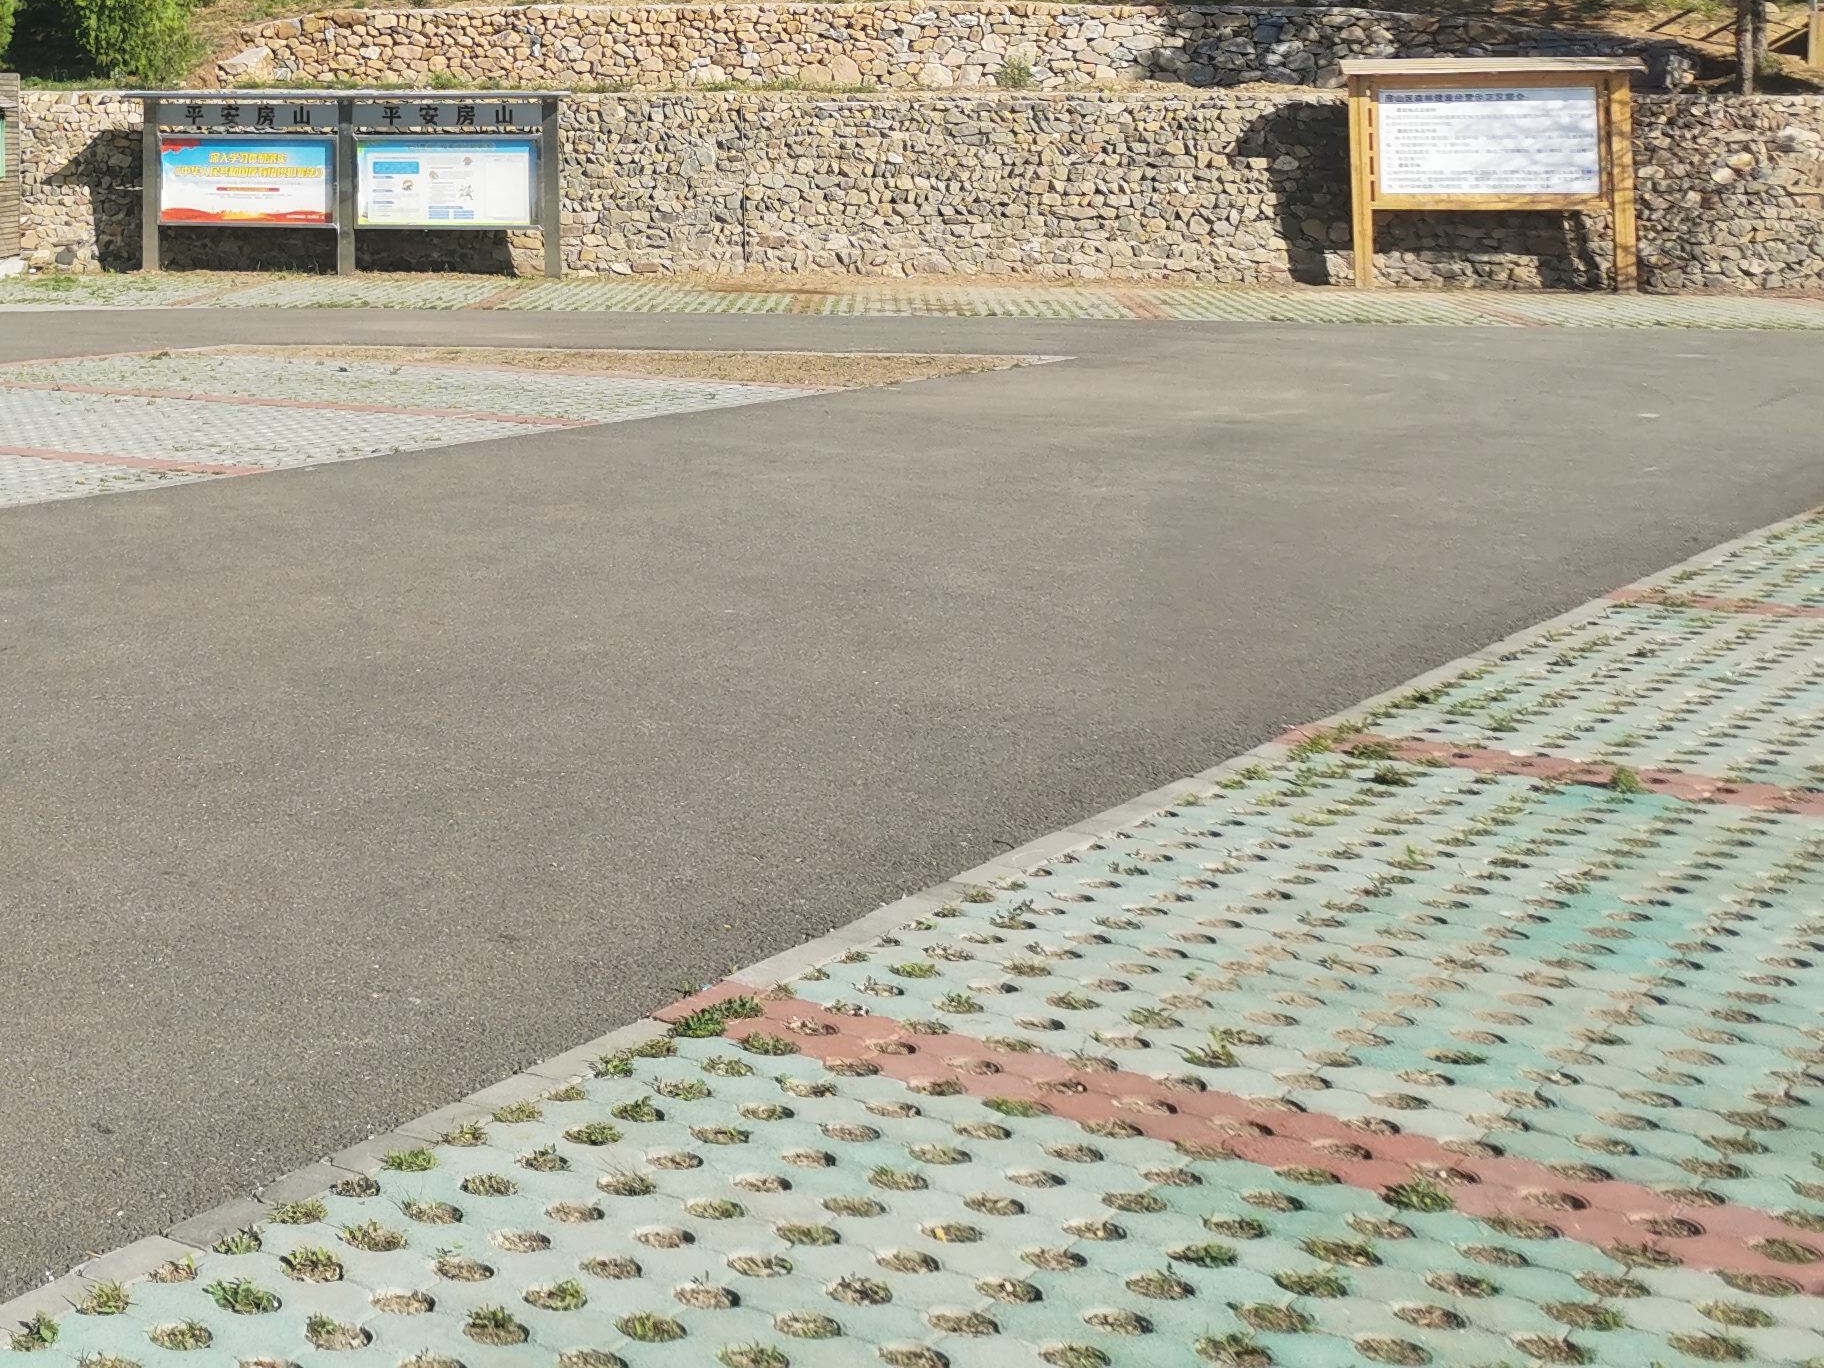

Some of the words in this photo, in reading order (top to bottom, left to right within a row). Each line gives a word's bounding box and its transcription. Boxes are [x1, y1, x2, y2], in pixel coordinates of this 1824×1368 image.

[185, 104, 311, 126] 平安房山
[382, 104, 514, 126] 平安房山
